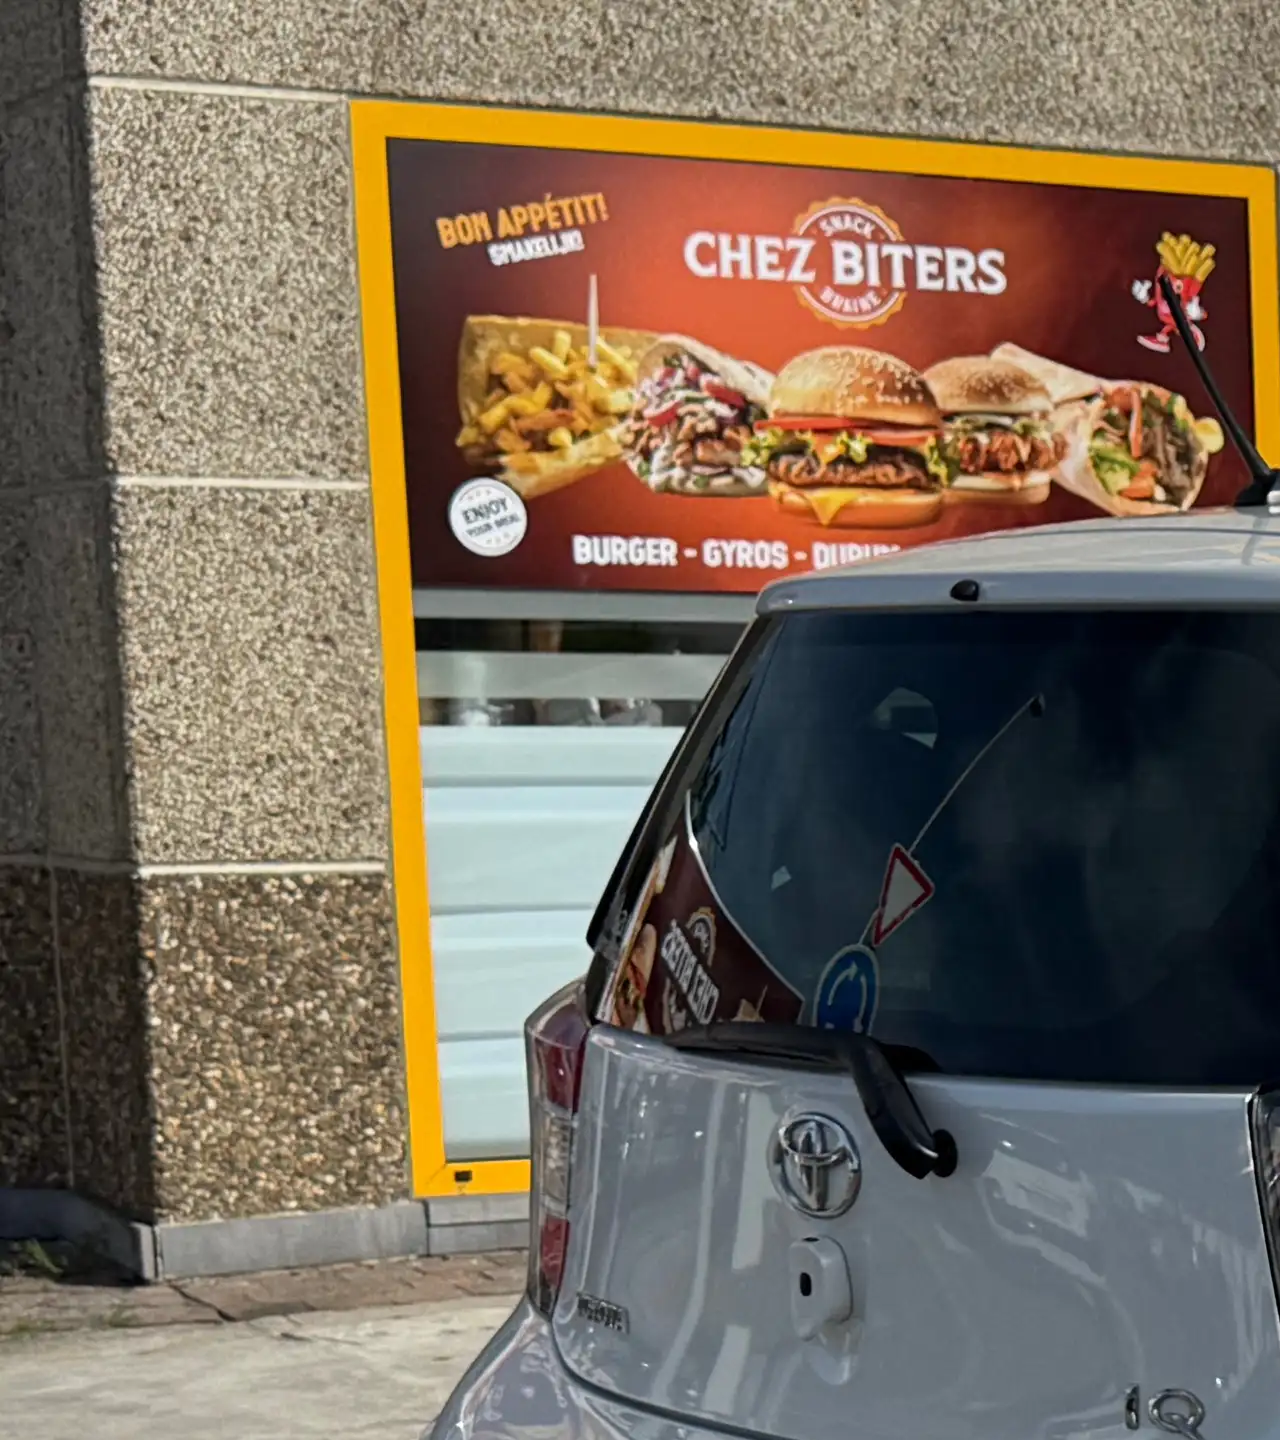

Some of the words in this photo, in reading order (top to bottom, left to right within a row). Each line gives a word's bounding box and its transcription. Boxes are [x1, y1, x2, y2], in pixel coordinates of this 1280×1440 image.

[436, 211, 493, 249] BON
[497, 192, 609, 238] APPÉTIT!
[819, 213, 877, 240] SNACK
[683, 230, 817, 284] CHEZ
[830, 240, 1008, 295] BITERS
[462, 497, 508, 524] ENJOY
[572, 535, 678, 566] BURGER
[702, 538, 789, 569] GYROS
